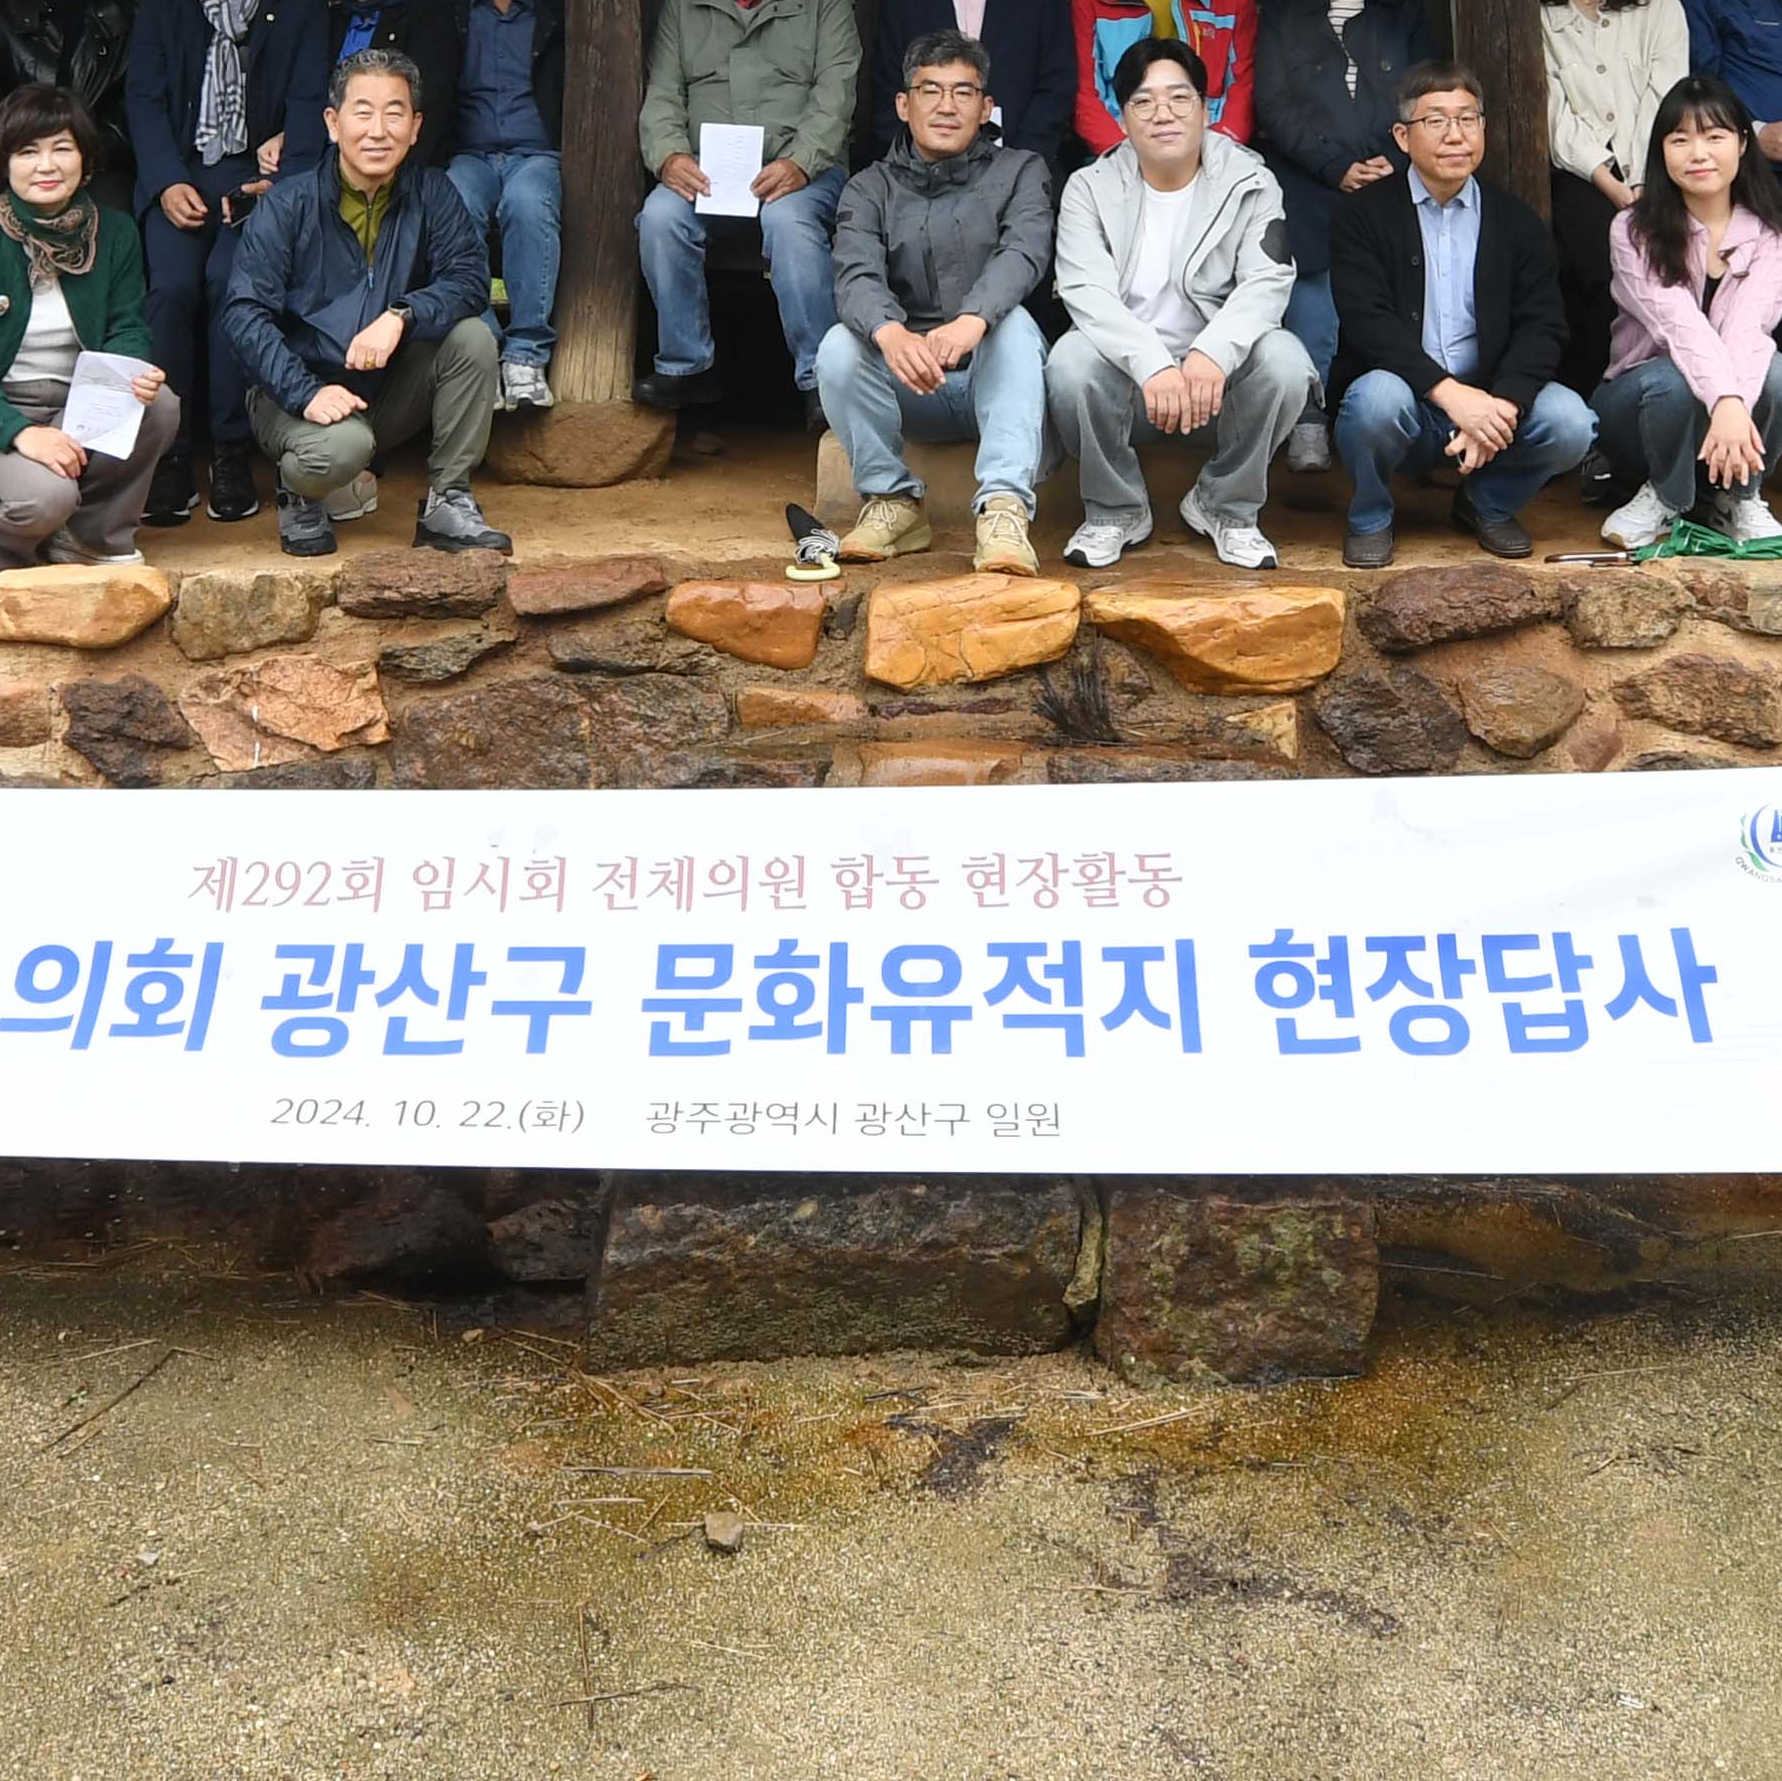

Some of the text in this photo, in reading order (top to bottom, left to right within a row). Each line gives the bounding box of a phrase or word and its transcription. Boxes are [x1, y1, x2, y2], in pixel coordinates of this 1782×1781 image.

[187, 850, 1184, 914] 제292회 임시회 전체의원 합동 현장활동
[260, 941, 594, 1060] 광산구
[640, 937, 1204, 1059] 문화유적지
[1247, 927, 1719, 1057] 현장답사
[270, 1097, 1061, 1138] 2024. 10. 22.(화) 광주광역시 광산구 일원
